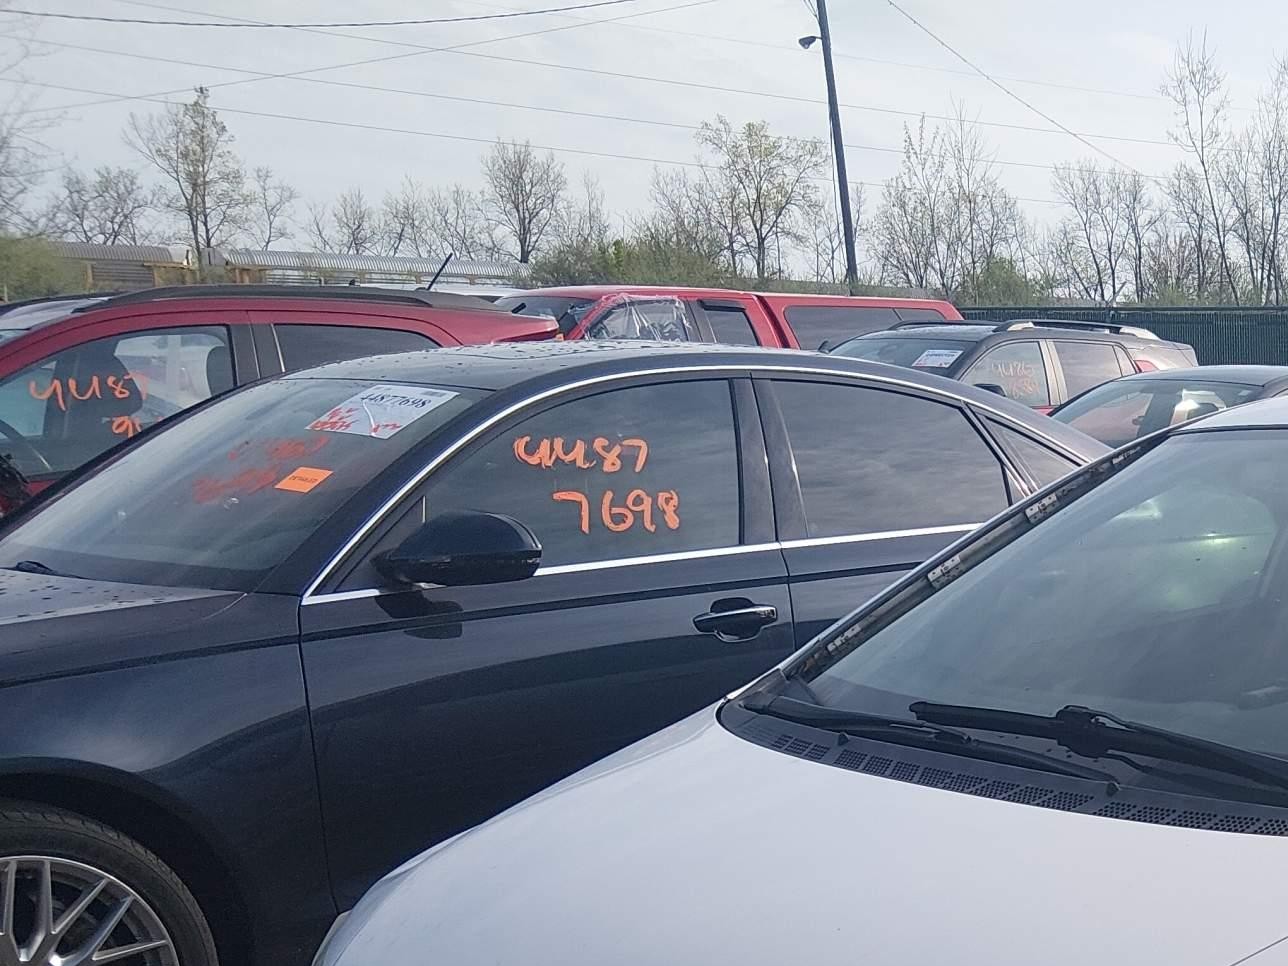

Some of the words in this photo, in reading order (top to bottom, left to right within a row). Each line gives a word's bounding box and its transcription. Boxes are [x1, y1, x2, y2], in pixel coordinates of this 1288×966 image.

[28, 370, 148, 412] 4487
[512, 435, 648, 473] 4487
[552, 489, 681, 534] 7698
